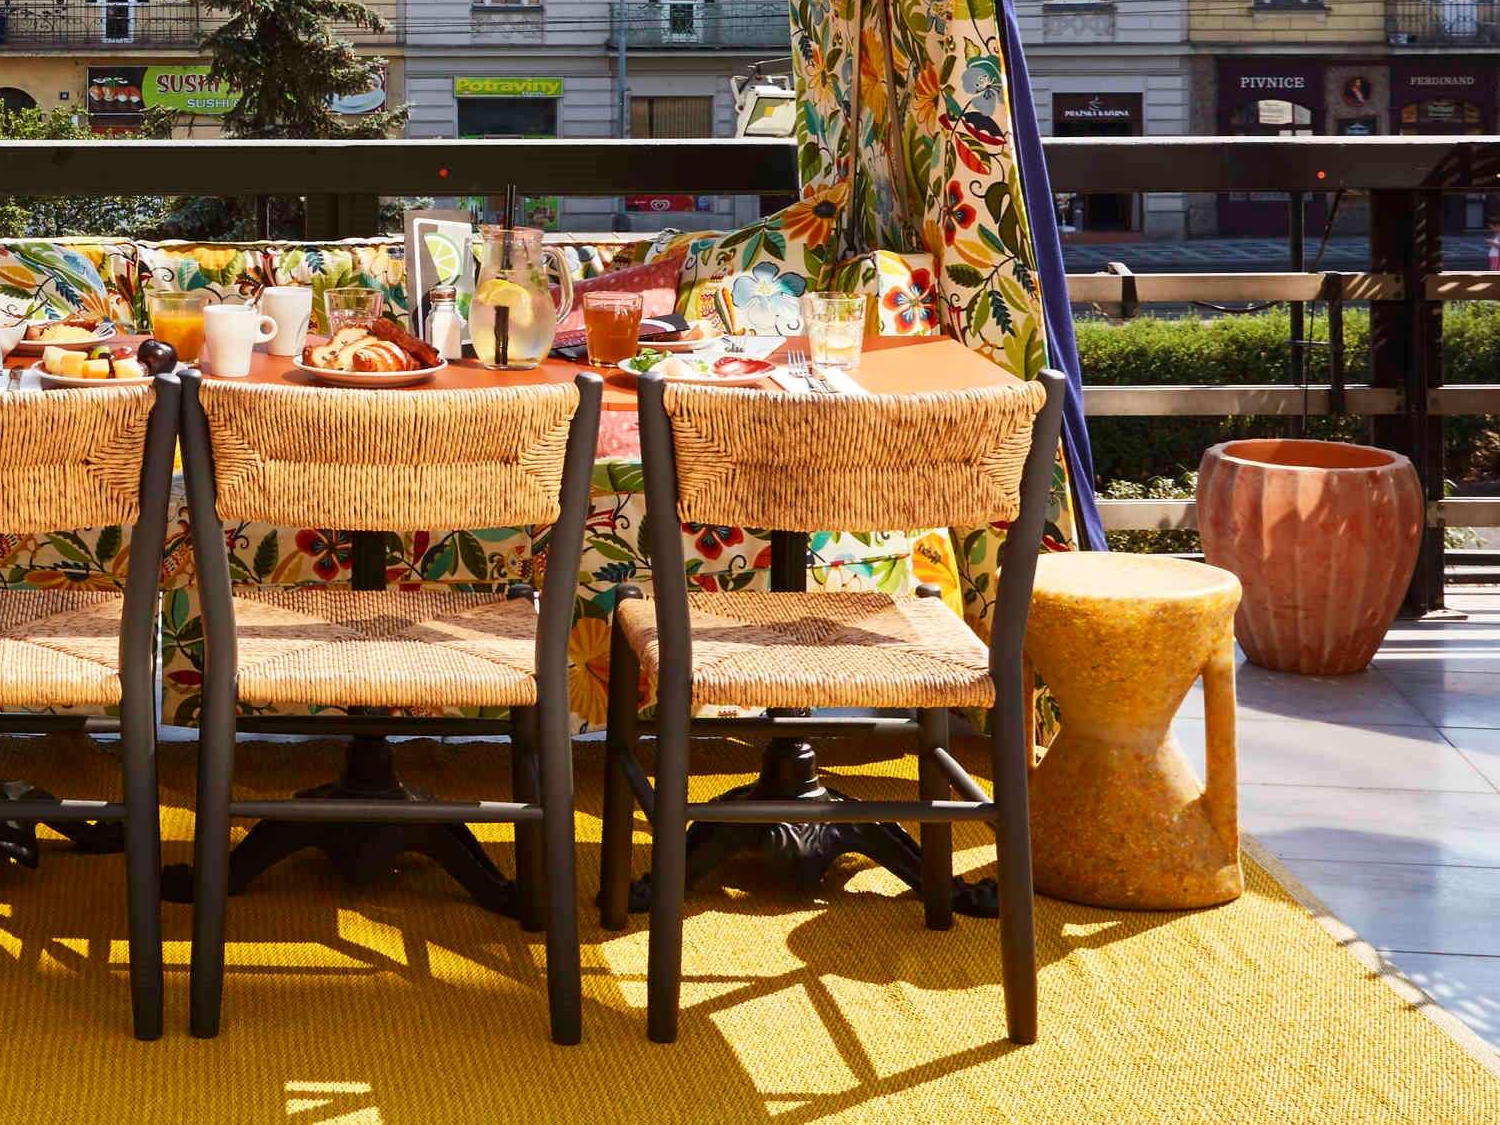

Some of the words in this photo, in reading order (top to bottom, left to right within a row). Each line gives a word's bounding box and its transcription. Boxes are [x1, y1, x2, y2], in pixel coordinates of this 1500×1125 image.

[456, 78, 560, 95] Potraviny
[1239, 76, 1305, 89] PIVNICE
[1409, 76, 1476, 86] FERDINAND
[187, 98, 230, 108] SUSHI
